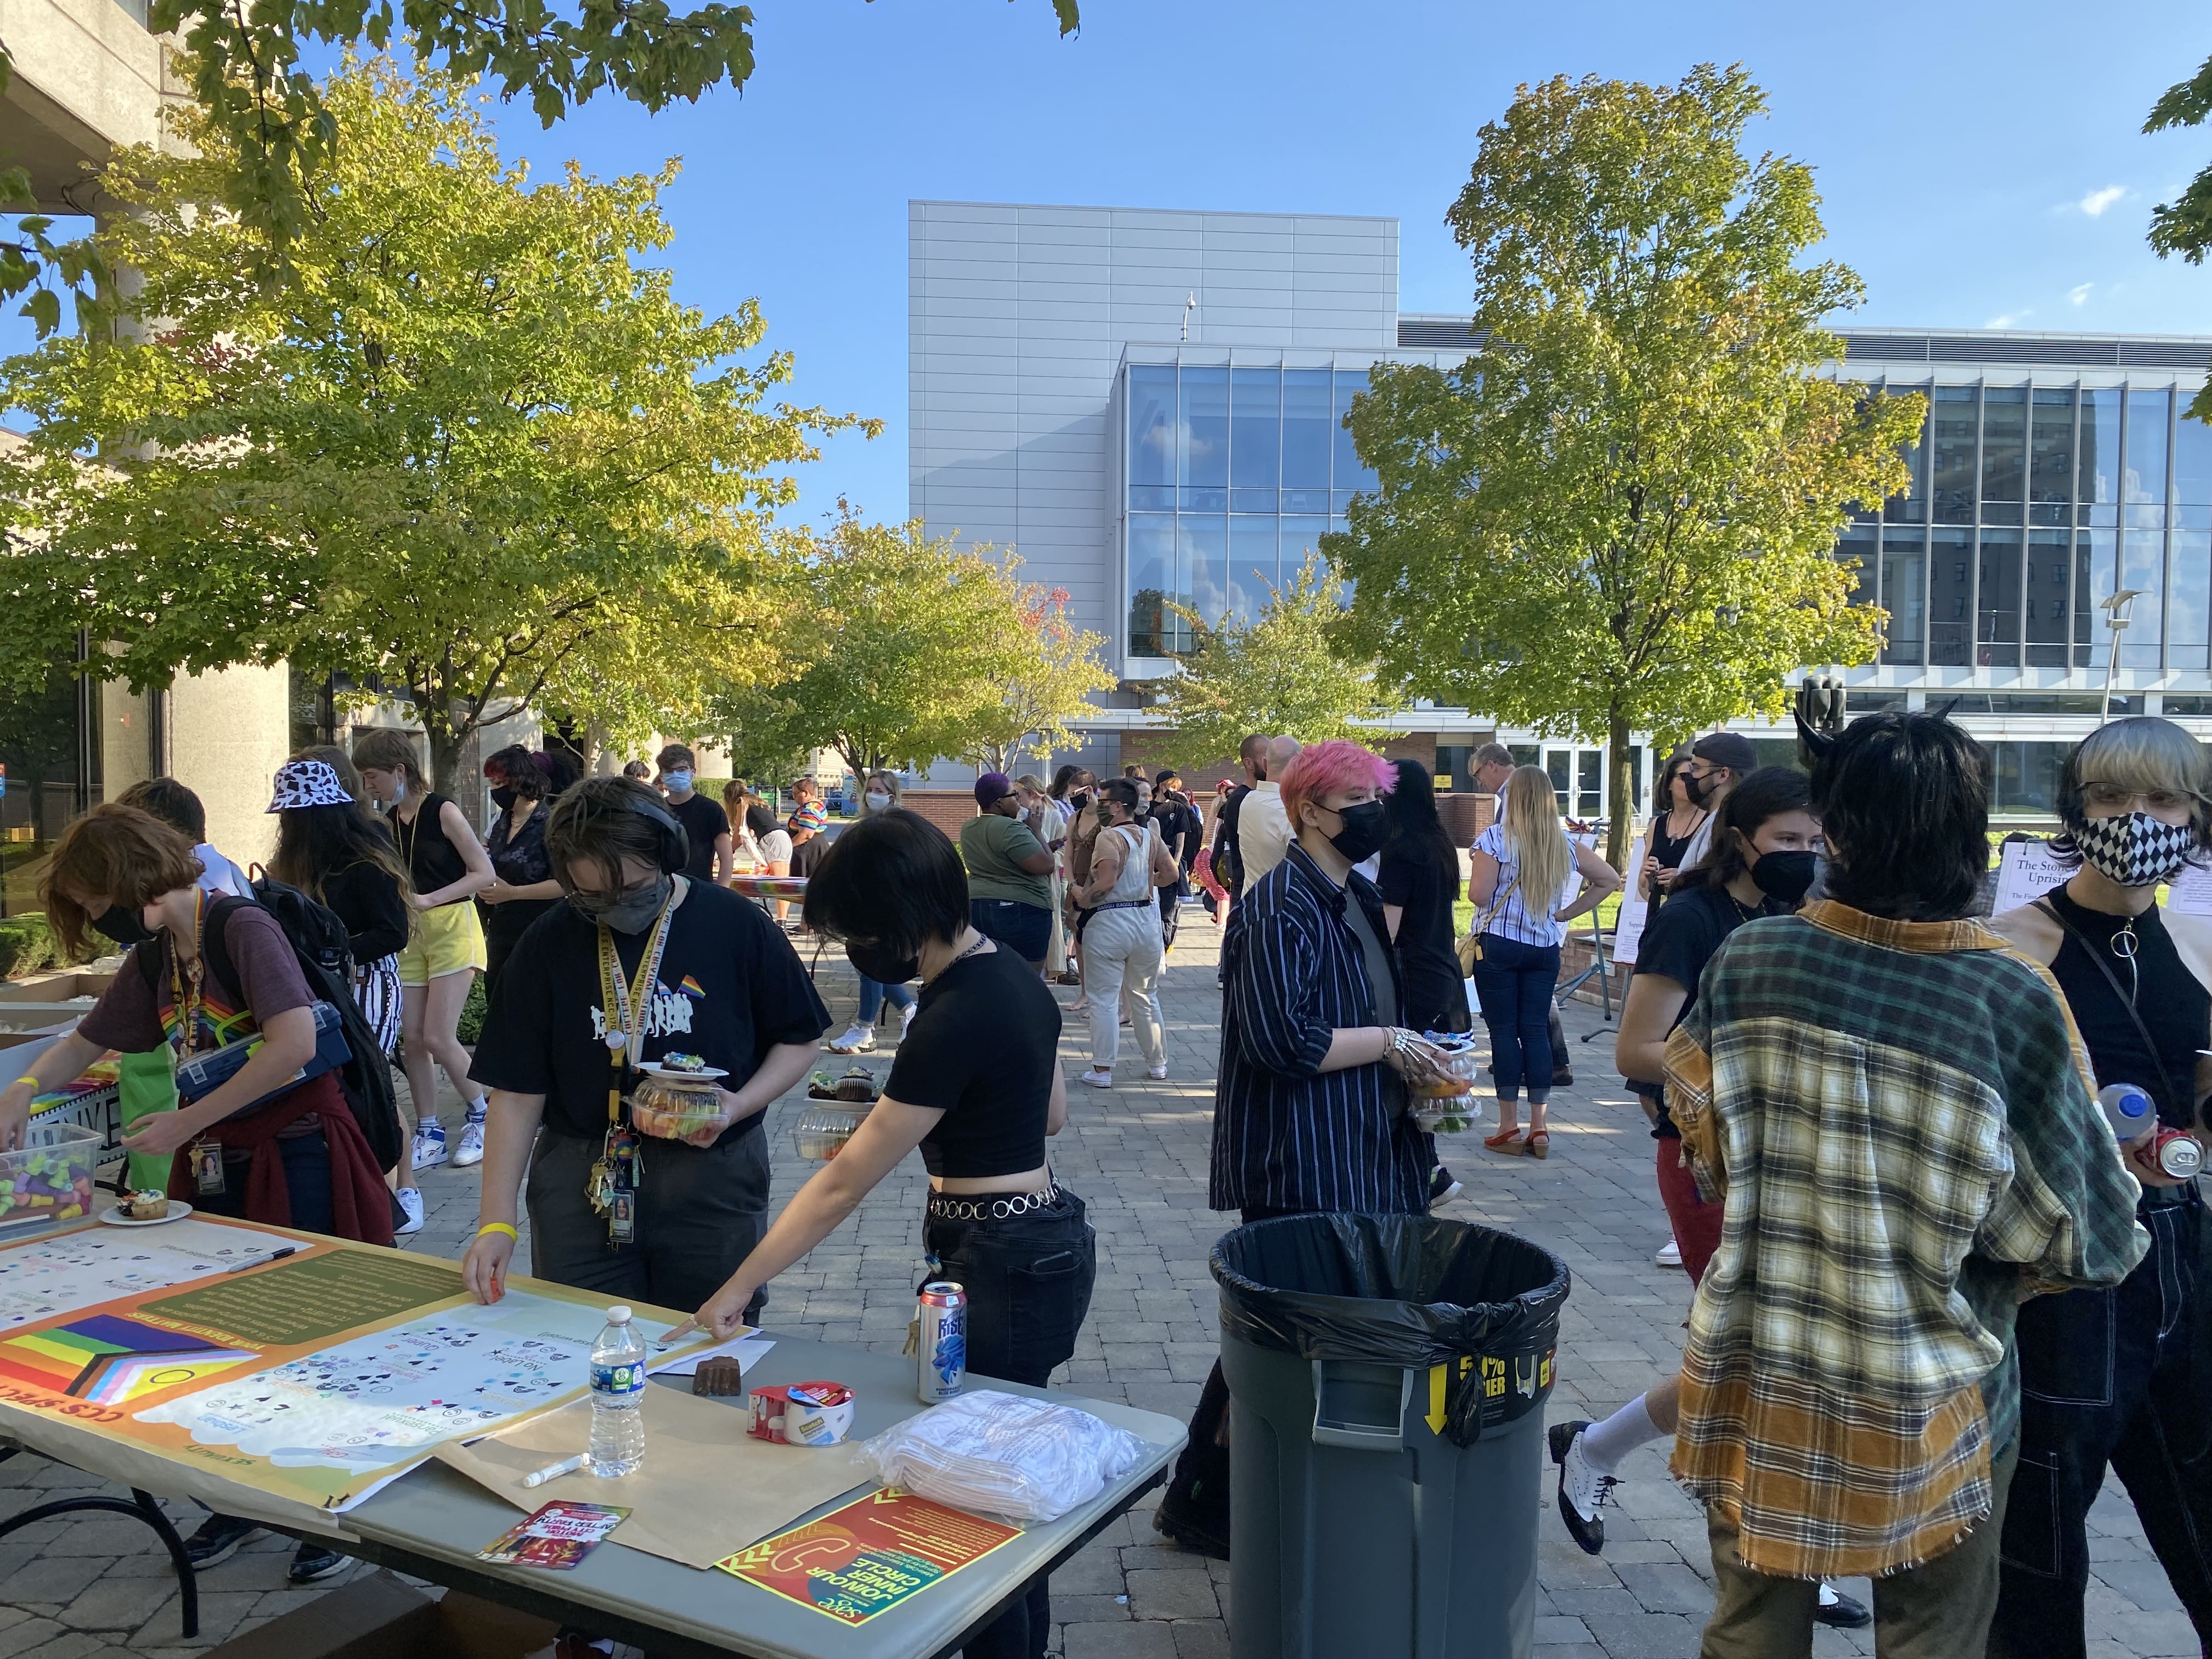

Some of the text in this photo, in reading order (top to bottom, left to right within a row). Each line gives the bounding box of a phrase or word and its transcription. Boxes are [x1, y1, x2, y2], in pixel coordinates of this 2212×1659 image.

[2017, 860, 2038, 870] The
[2029, 872, 2068, 885] Uprisin
[601, 947, 614, 995] ENTERPRISE
[606, 997, 617, 1030] NCC-170
[178, 1321, 234, 1342] IDENTITY
[938, 1317, 965, 1340] RISE
[228, 1335, 266, 1350] YOUR
[402, 1336, 441, 1352] Queer
[489, 1354, 541, 1372] No Label
[59, 1398, 124, 1423] CCS
[196, 1414, 247, 1435] Lesbian
[379, 1412, 443, 1436] Pansexual
[800, 1418, 823, 1432] Scotch
[180, 1443, 257, 1466] SEXUALITY
[315, 1447, 349, 1458] Gay
[534, 1517, 574, 1526] PARTY
[805, 1565, 894, 1600] JOIN OUR
[847, 1569, 909, 1595] INNER
[817, 1596, 862, 1619] sage
